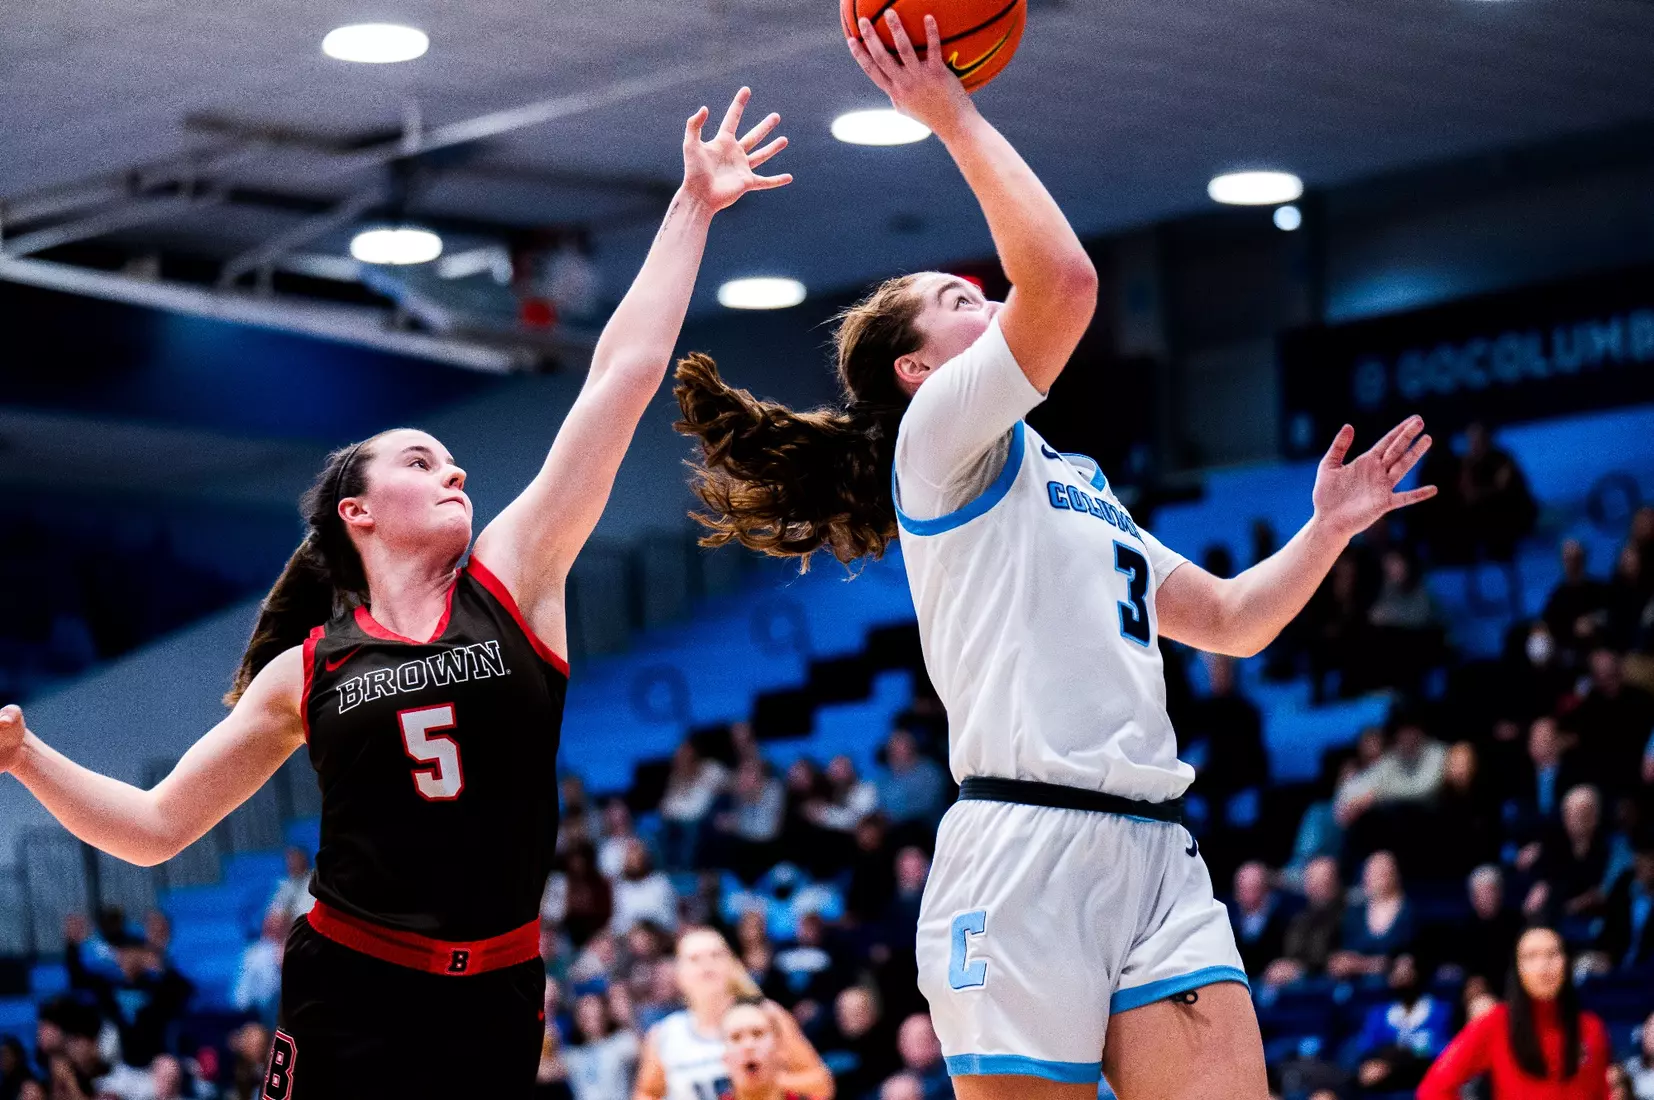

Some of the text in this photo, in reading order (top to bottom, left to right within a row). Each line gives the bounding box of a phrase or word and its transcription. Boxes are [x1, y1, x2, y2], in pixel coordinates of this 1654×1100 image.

[1047, 480, 1143, 541] COLUM
[1112, 539, 1150, 648] 3
[336, 640, 505, 714] BROWN
[396, 702, 465, 802] 5
[446, 948, 472, 974] B
[948, 908, 988, 991] C
[260, 1027, 297, 1100] B
